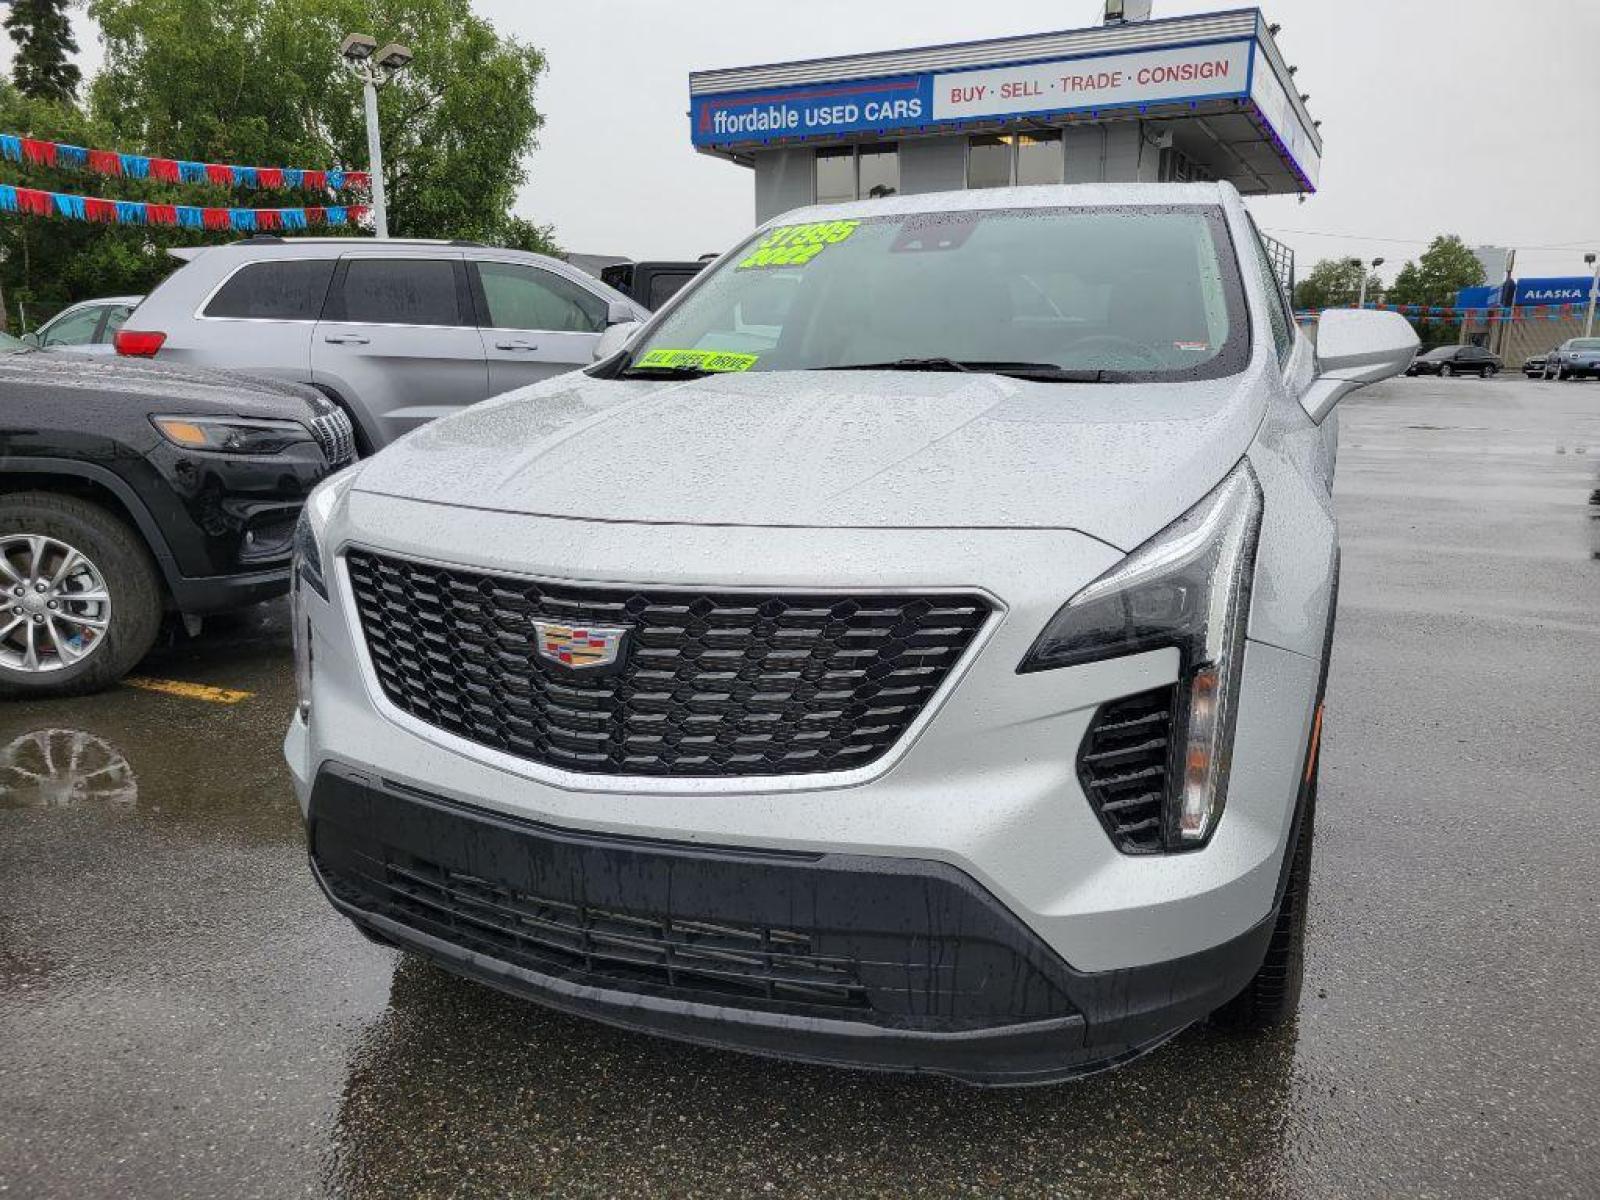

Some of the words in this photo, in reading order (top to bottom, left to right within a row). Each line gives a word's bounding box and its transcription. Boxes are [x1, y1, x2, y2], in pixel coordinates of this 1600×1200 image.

[950, 85, 987, 104] BUY
[1000, 79, 1043, 99] SELL
[1060, 70, 1122, 93] TRADE
[1137, 60, 1230, 86] CONSIGN
[701, 103, 799, 134] Affordable
[805, 104, 859, 127] USED
[865, 98, 922, 121] CARS
[1524, 289, 1581, 299] ALASKA
[709, 354, 750, 370] DRIVE
